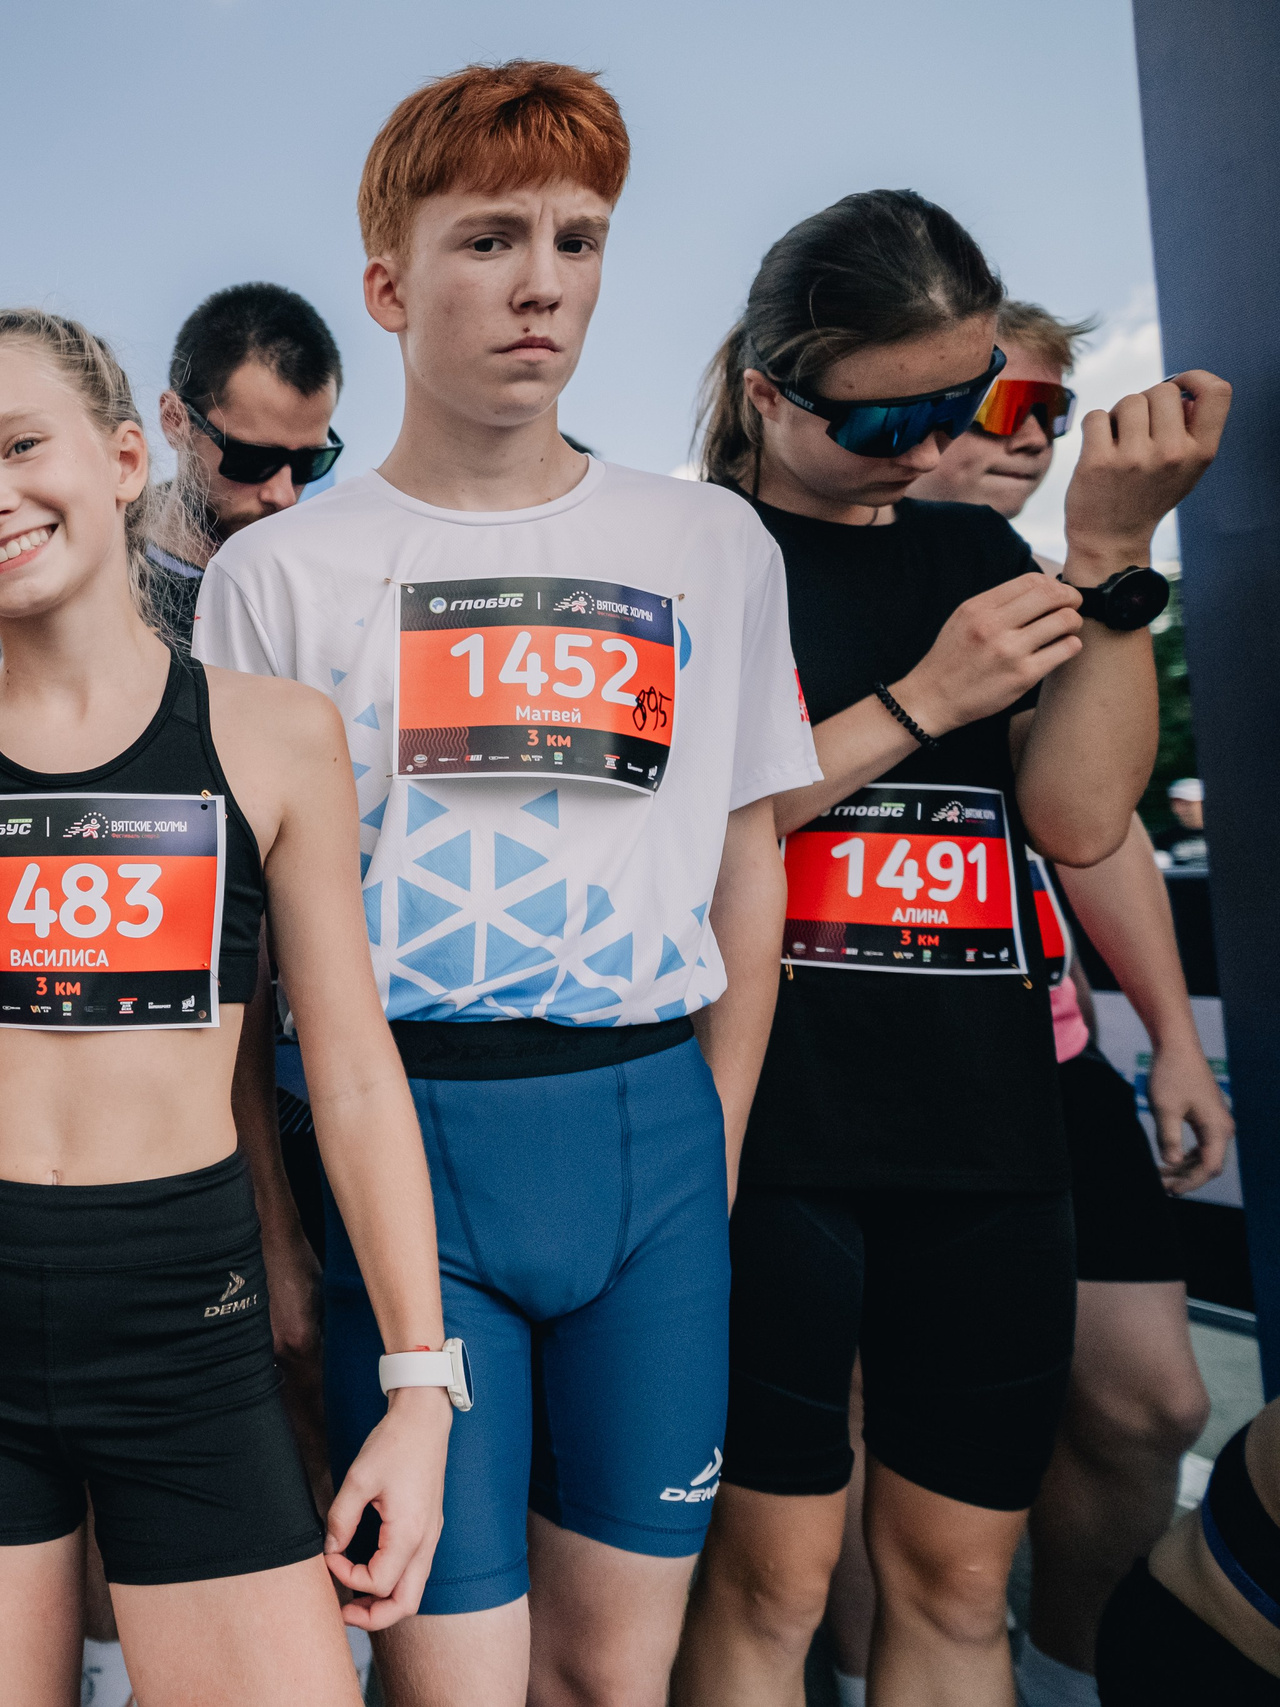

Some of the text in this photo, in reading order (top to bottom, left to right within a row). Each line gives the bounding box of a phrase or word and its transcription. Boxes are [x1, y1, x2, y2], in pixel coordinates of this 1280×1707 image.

[450, 597, 523, 611] ГЛОБУС
[596, 599, 653, 622] ВЯТСКИЕ ХОЛМЫ
[450, 631, 638, 708] 1452
[515, 705, 581, 724] Матвей
[632, 686, 672, 731] 895
[527, 730, 571, 748] 3 км
[834, 805, 905, 818] ГЛОБУС
[111, 820, 188, 832] ВЯТСКИЕ ХОЛМЫ
[831, 837, 987, 903] 1491
[892, 906, 948, 925] АЛИНА
[900, 929, 911, 946] 3
[10, 948, 109, 967] ВАСИЛИСА
[35, 976, 81, 996] 3 км
